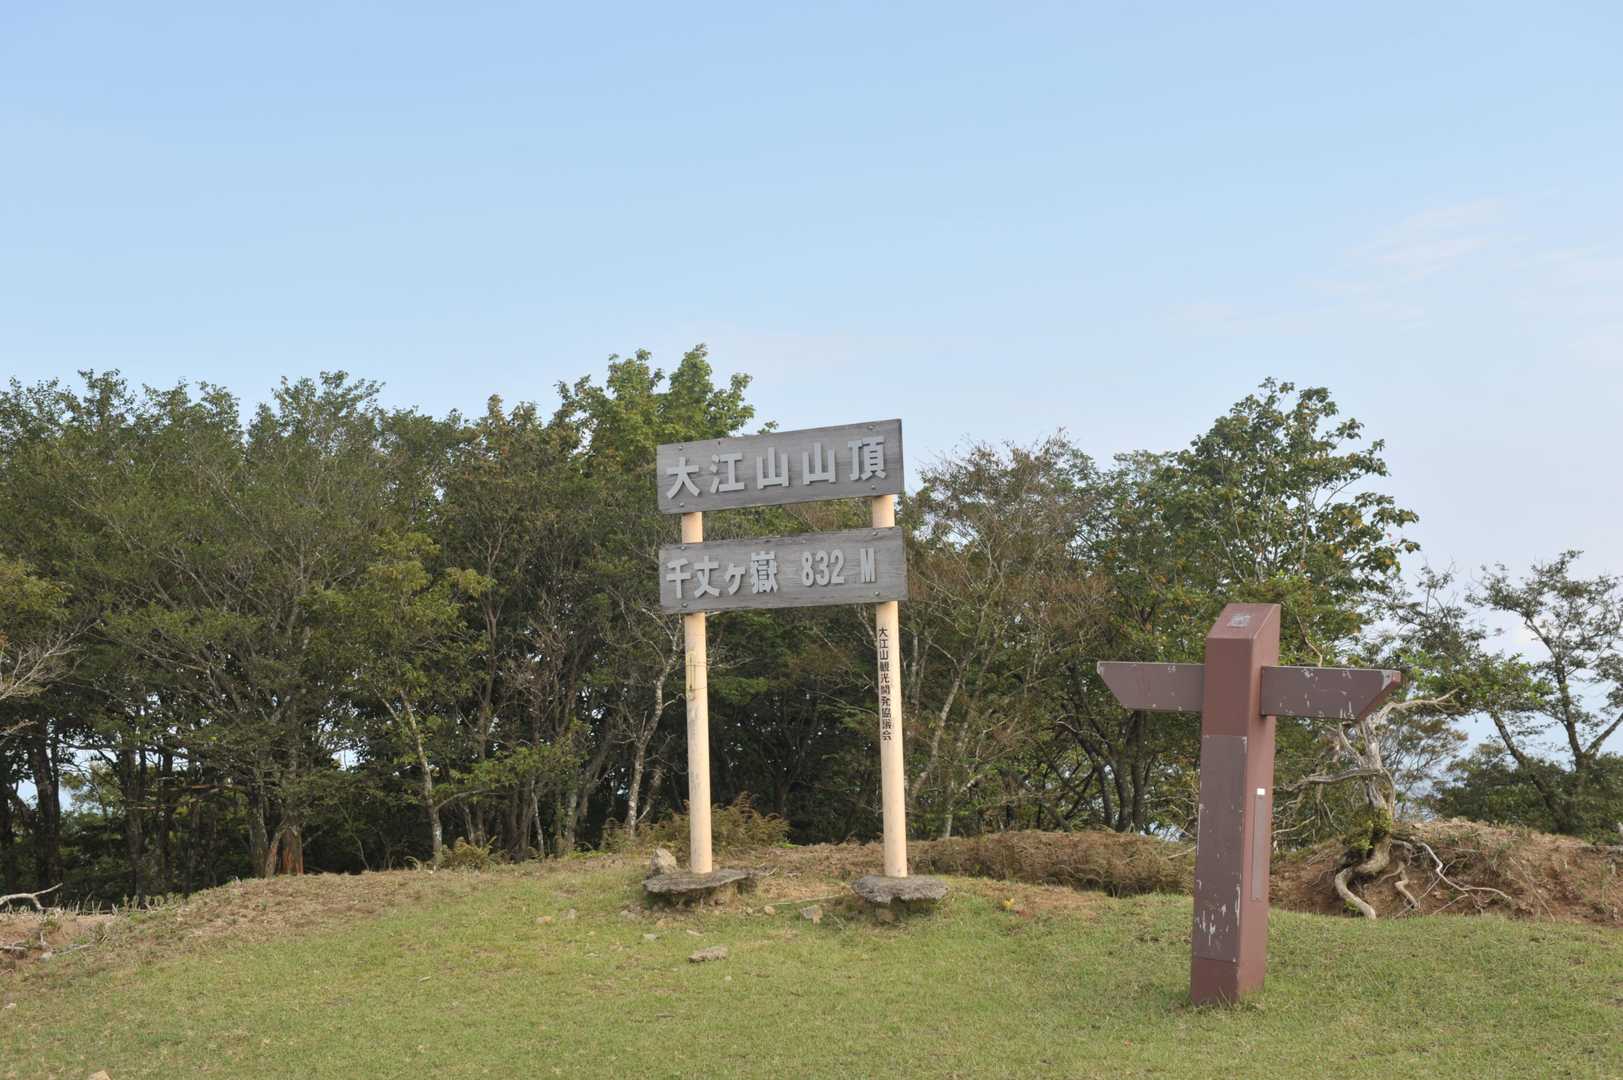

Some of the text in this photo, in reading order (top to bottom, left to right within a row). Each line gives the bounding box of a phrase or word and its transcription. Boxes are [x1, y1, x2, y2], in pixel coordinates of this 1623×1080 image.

[666, 435, 887, 499] 大江山山頂
[802, 549, 845, 587] 832
[859, 548, 876, 583] M
